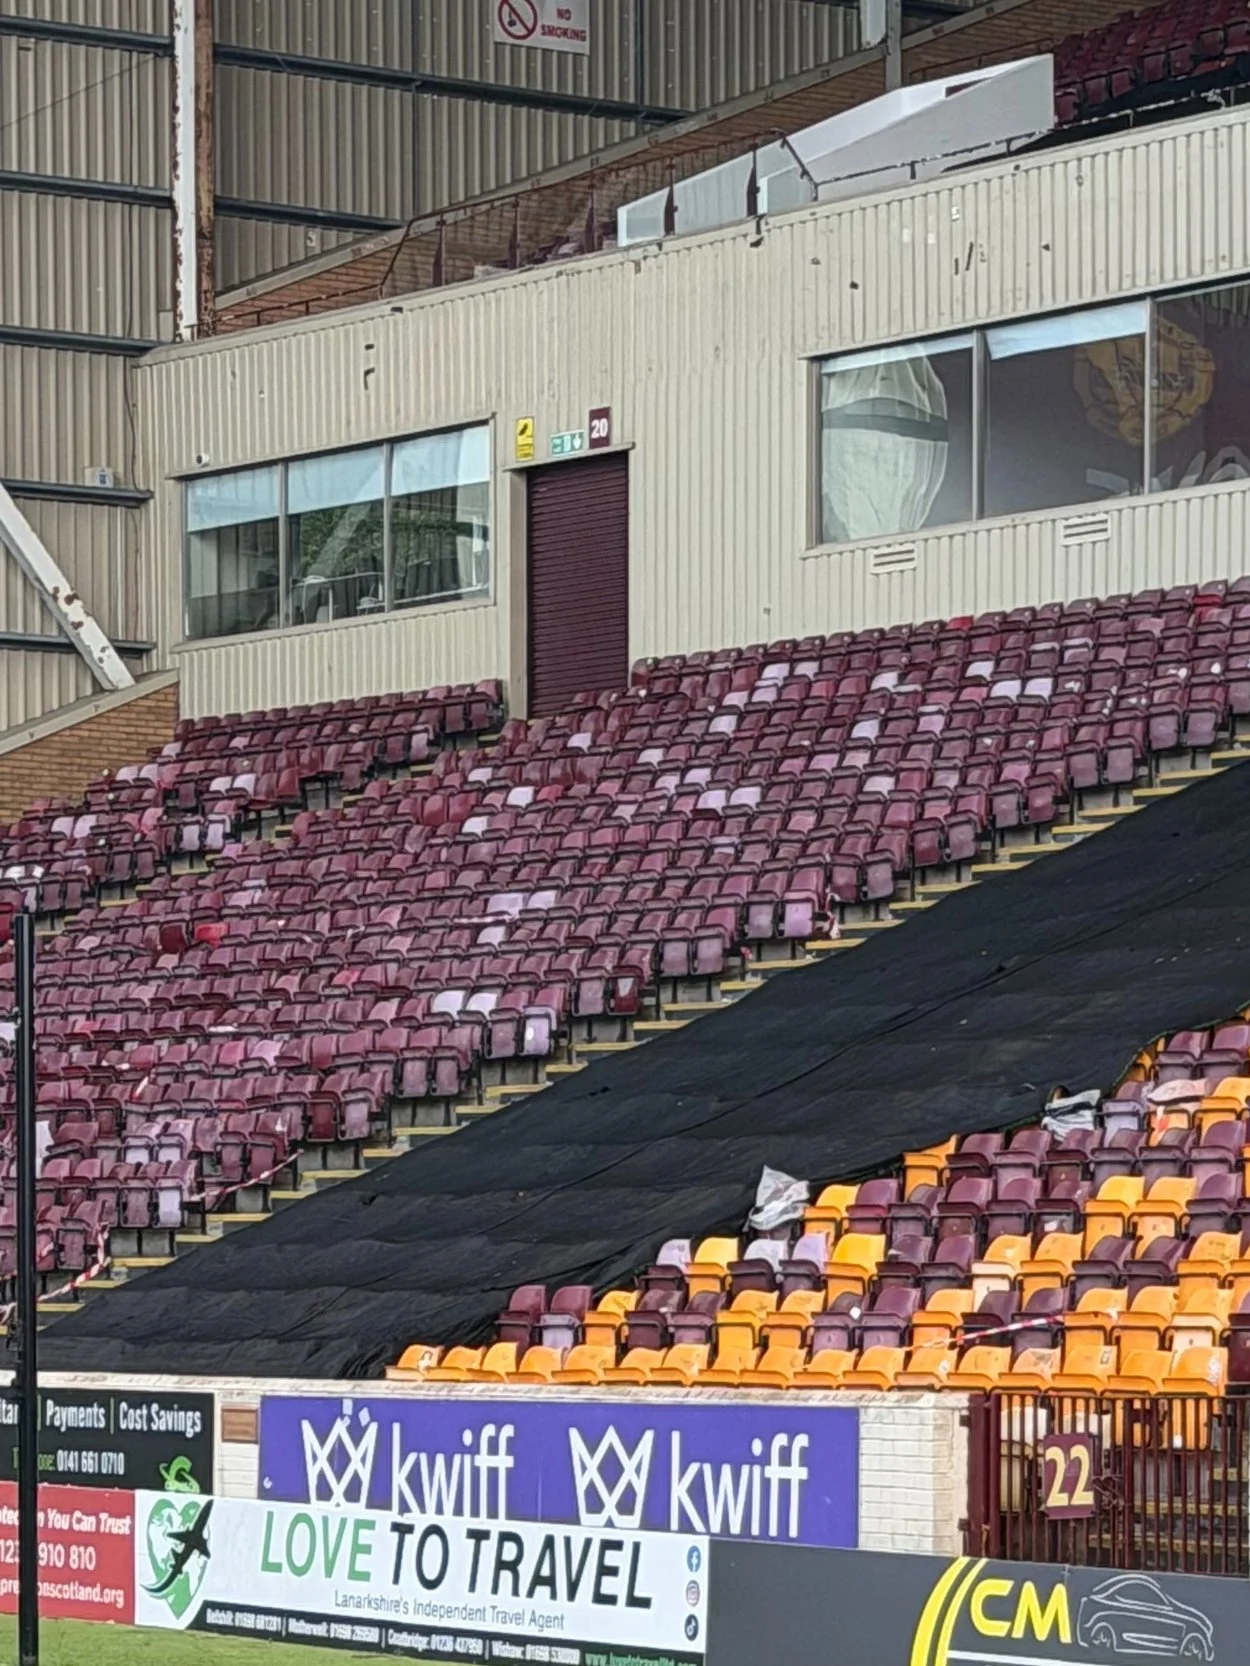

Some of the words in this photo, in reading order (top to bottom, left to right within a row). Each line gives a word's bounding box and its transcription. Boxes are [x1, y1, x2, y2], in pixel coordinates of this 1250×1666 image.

[541, 24, 587, 42] SMOKING
[591, 418, 608, 439] 20
[46, 1399, 105, 1432] Payments
[119, 1401, 147, 1431] Cost
[151, 1403, 201, 1438] Savings
[57, 1449, 79, 1472] 0141
[81, 1451, 99, 1473] 661
[101, 1452, 124, 1475] 0710
[391, 1422, 514, 1521] kwiff
[1045, 1445, 1094, 1508] 22
[670, 1431, 808, 1538] kwiff
[47, 1507, 70, 1530] You
[72, 1510, 96, 1532] Can
[99, 1512, 131, 1535] Trust
[38, 1542, 65, 1568] 910
[69, 1544, 96, 1571] 810
[261, 1510, 376, 1582] LOVE
[390, 1522, 450, 1590] TO
[465, 1528, 653, 1609] TRAVEL
[335, 1590, 409, 1615] Lanarkshire's
[413, 1598, 487, 1622] Independent
[490, 1605, 525, 1626] Travel
[529, 1609, 565, 1632] Agent
[970, 1579, 1072, 1643] CM
